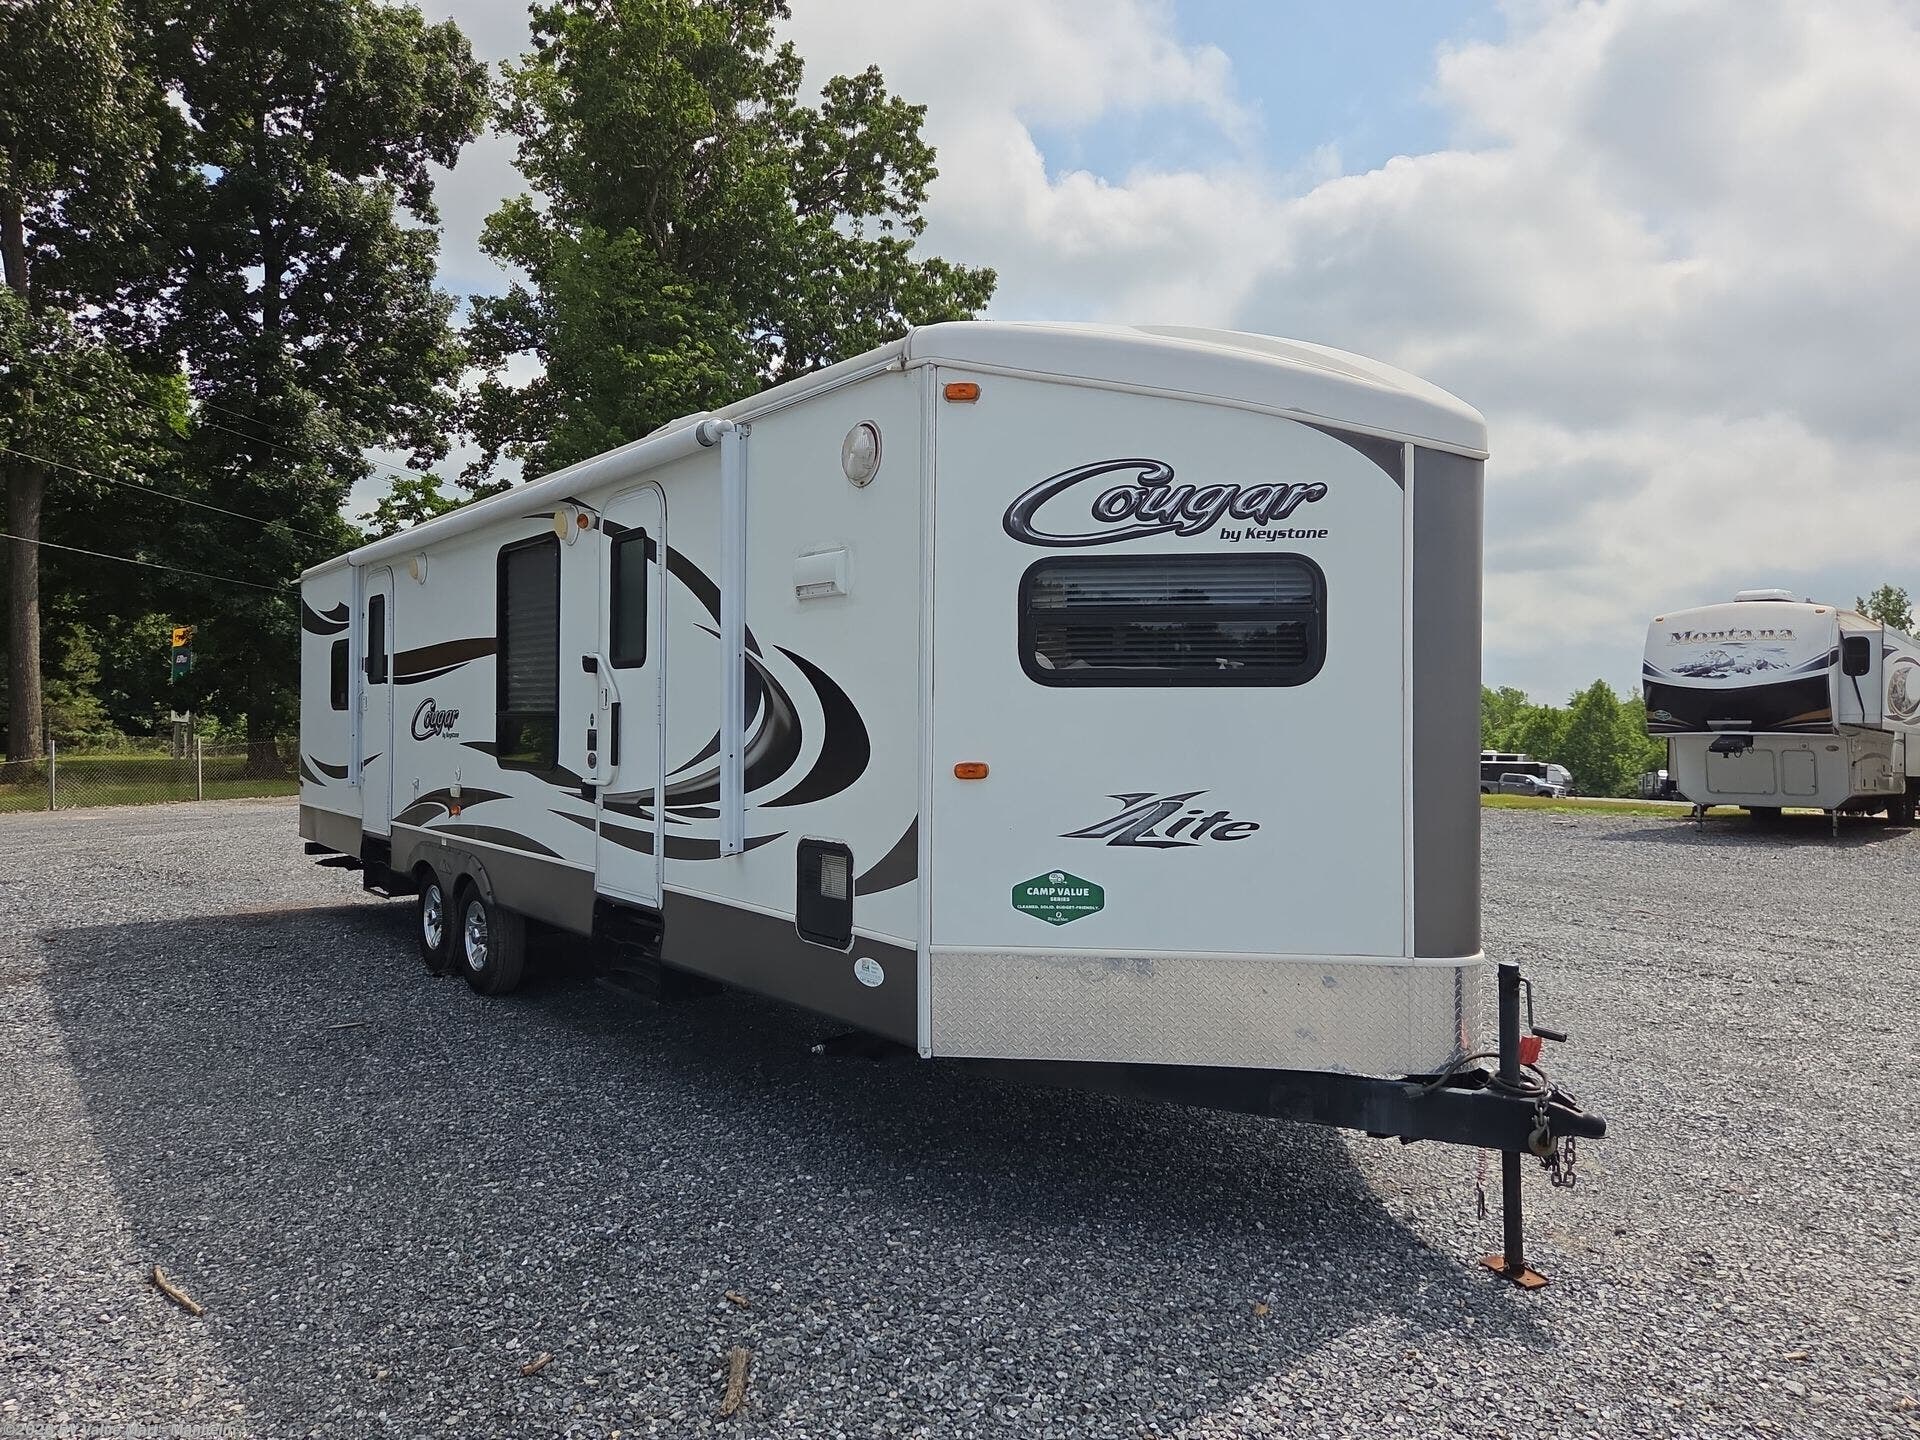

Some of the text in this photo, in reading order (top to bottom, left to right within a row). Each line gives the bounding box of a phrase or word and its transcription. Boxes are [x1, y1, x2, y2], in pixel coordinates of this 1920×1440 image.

[1002, 457, 1328, 548] Cougar
[1219, 527, 1329, 543] by Keystone
[1671, 627, 1797, 643] Montana
[411, 697, 460, 741] Cougar
[1026, 887, 1090, 897] CAMP VALUE
